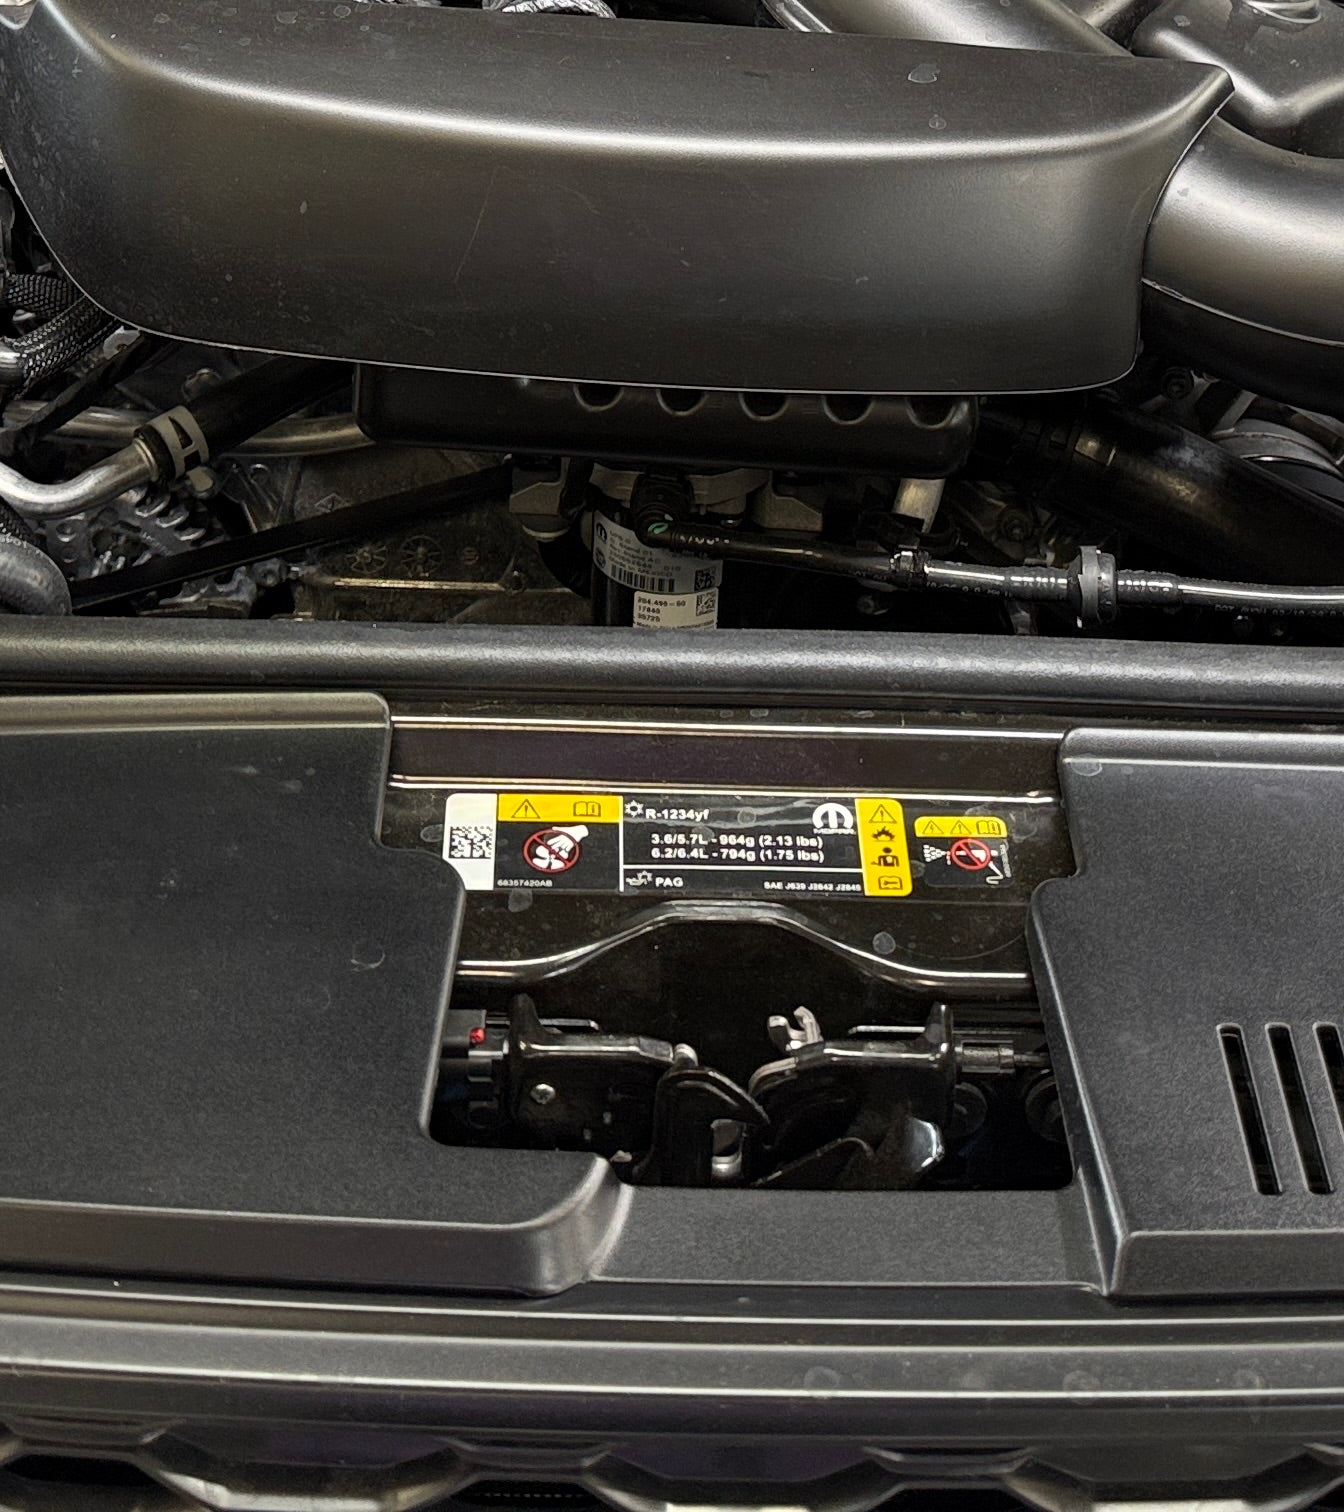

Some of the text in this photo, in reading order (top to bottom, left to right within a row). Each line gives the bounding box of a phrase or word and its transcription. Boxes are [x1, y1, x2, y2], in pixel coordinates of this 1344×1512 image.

[645, 808, 710, 822] R-1234yf
[651, 833, 709, 845] 3.6/5.7L
[719, 834, 755, 848] 964g
[758, 834, 794, 848] (2.13
[796, 835, 824, 849] lbs)
[651, 847, 709, 860] 6.2/6.4L
[720, 848, 756, 862] 794g
[759, 849, 795, 863] (1.75
[797, 849, 825, 863] lbs)
[655, 876, 684, 887] PAG
[763, 881, 784, 890] SAE
